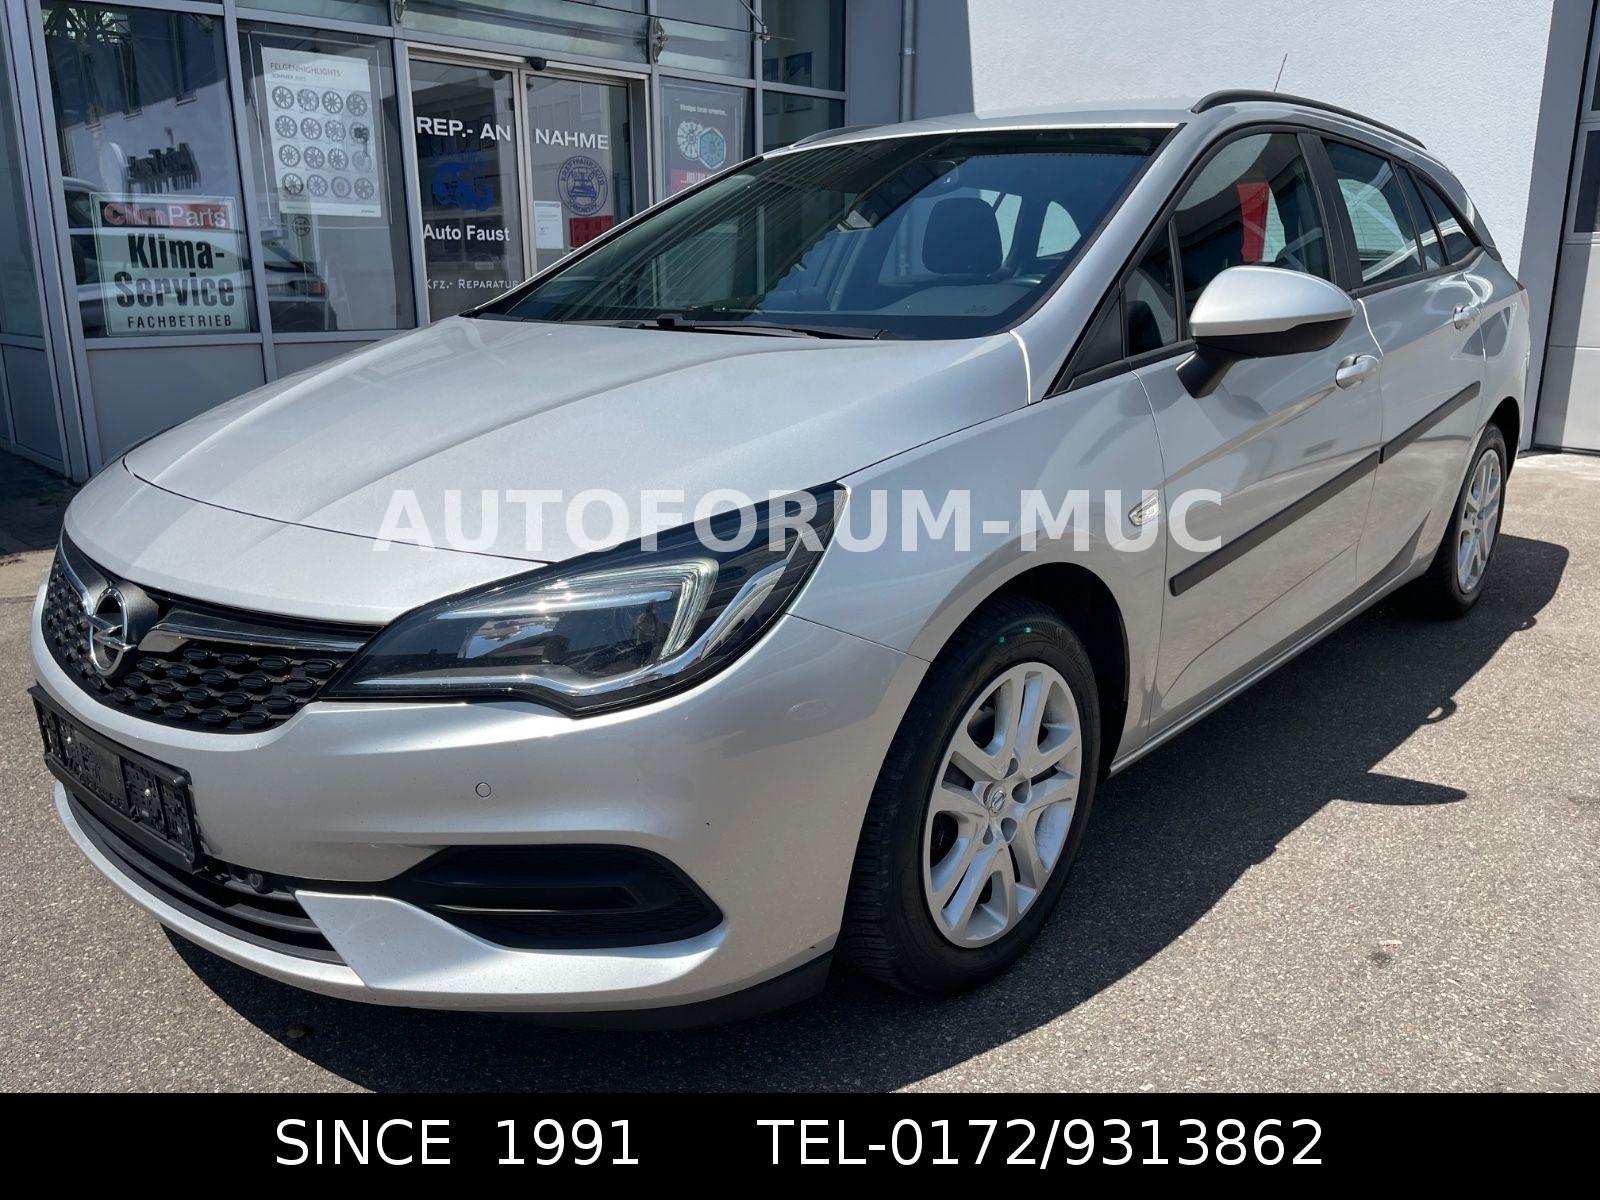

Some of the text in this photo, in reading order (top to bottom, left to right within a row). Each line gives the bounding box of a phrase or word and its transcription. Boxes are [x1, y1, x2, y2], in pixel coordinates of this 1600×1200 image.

[416, 116, 609, 150] REP.- AN NAHME
[423, 223, 510, 242] Auto Faust
[127, 233, 225, 269] Klima-
[114, 271, 235, 308] Service
[127, 314, 232, 329] FACHBETRIEB
